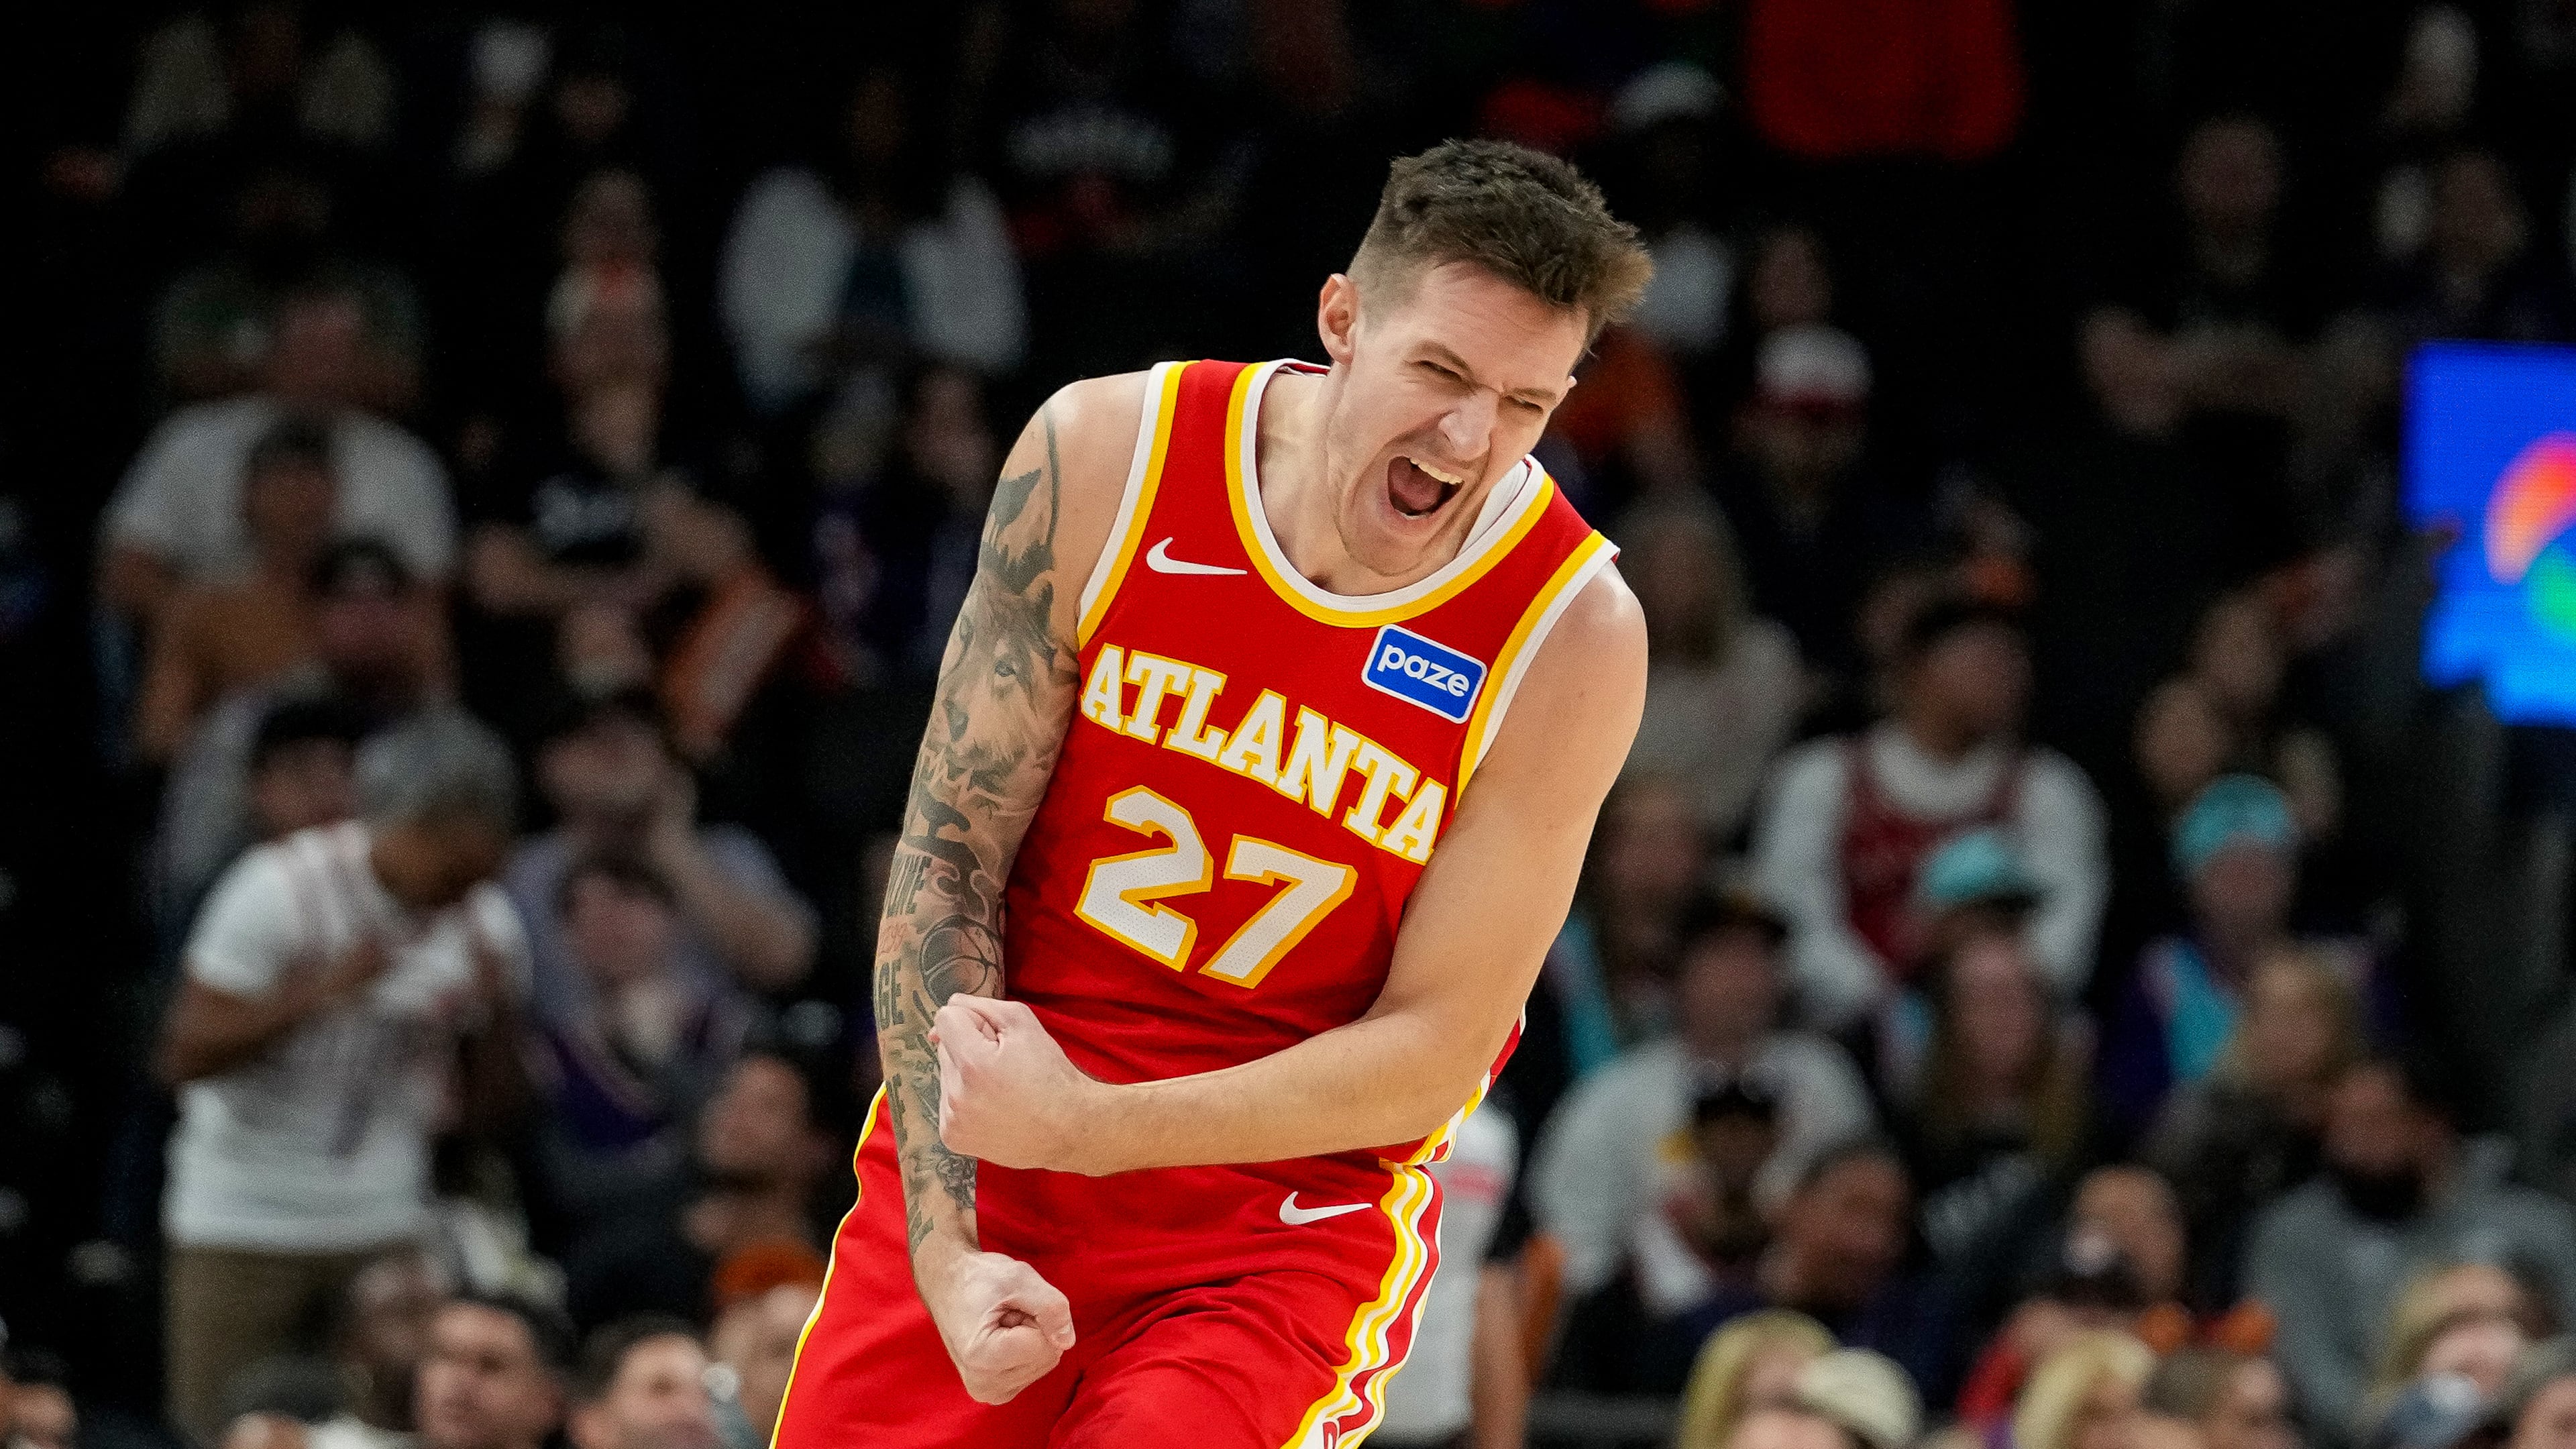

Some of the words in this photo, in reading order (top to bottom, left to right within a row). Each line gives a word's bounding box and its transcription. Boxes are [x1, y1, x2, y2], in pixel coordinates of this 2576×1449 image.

[1080, 642, 1449, 866] ATLANTA
[1377, 644, 1469, 697] paze
[1073, 784, 1358, 989] 27
